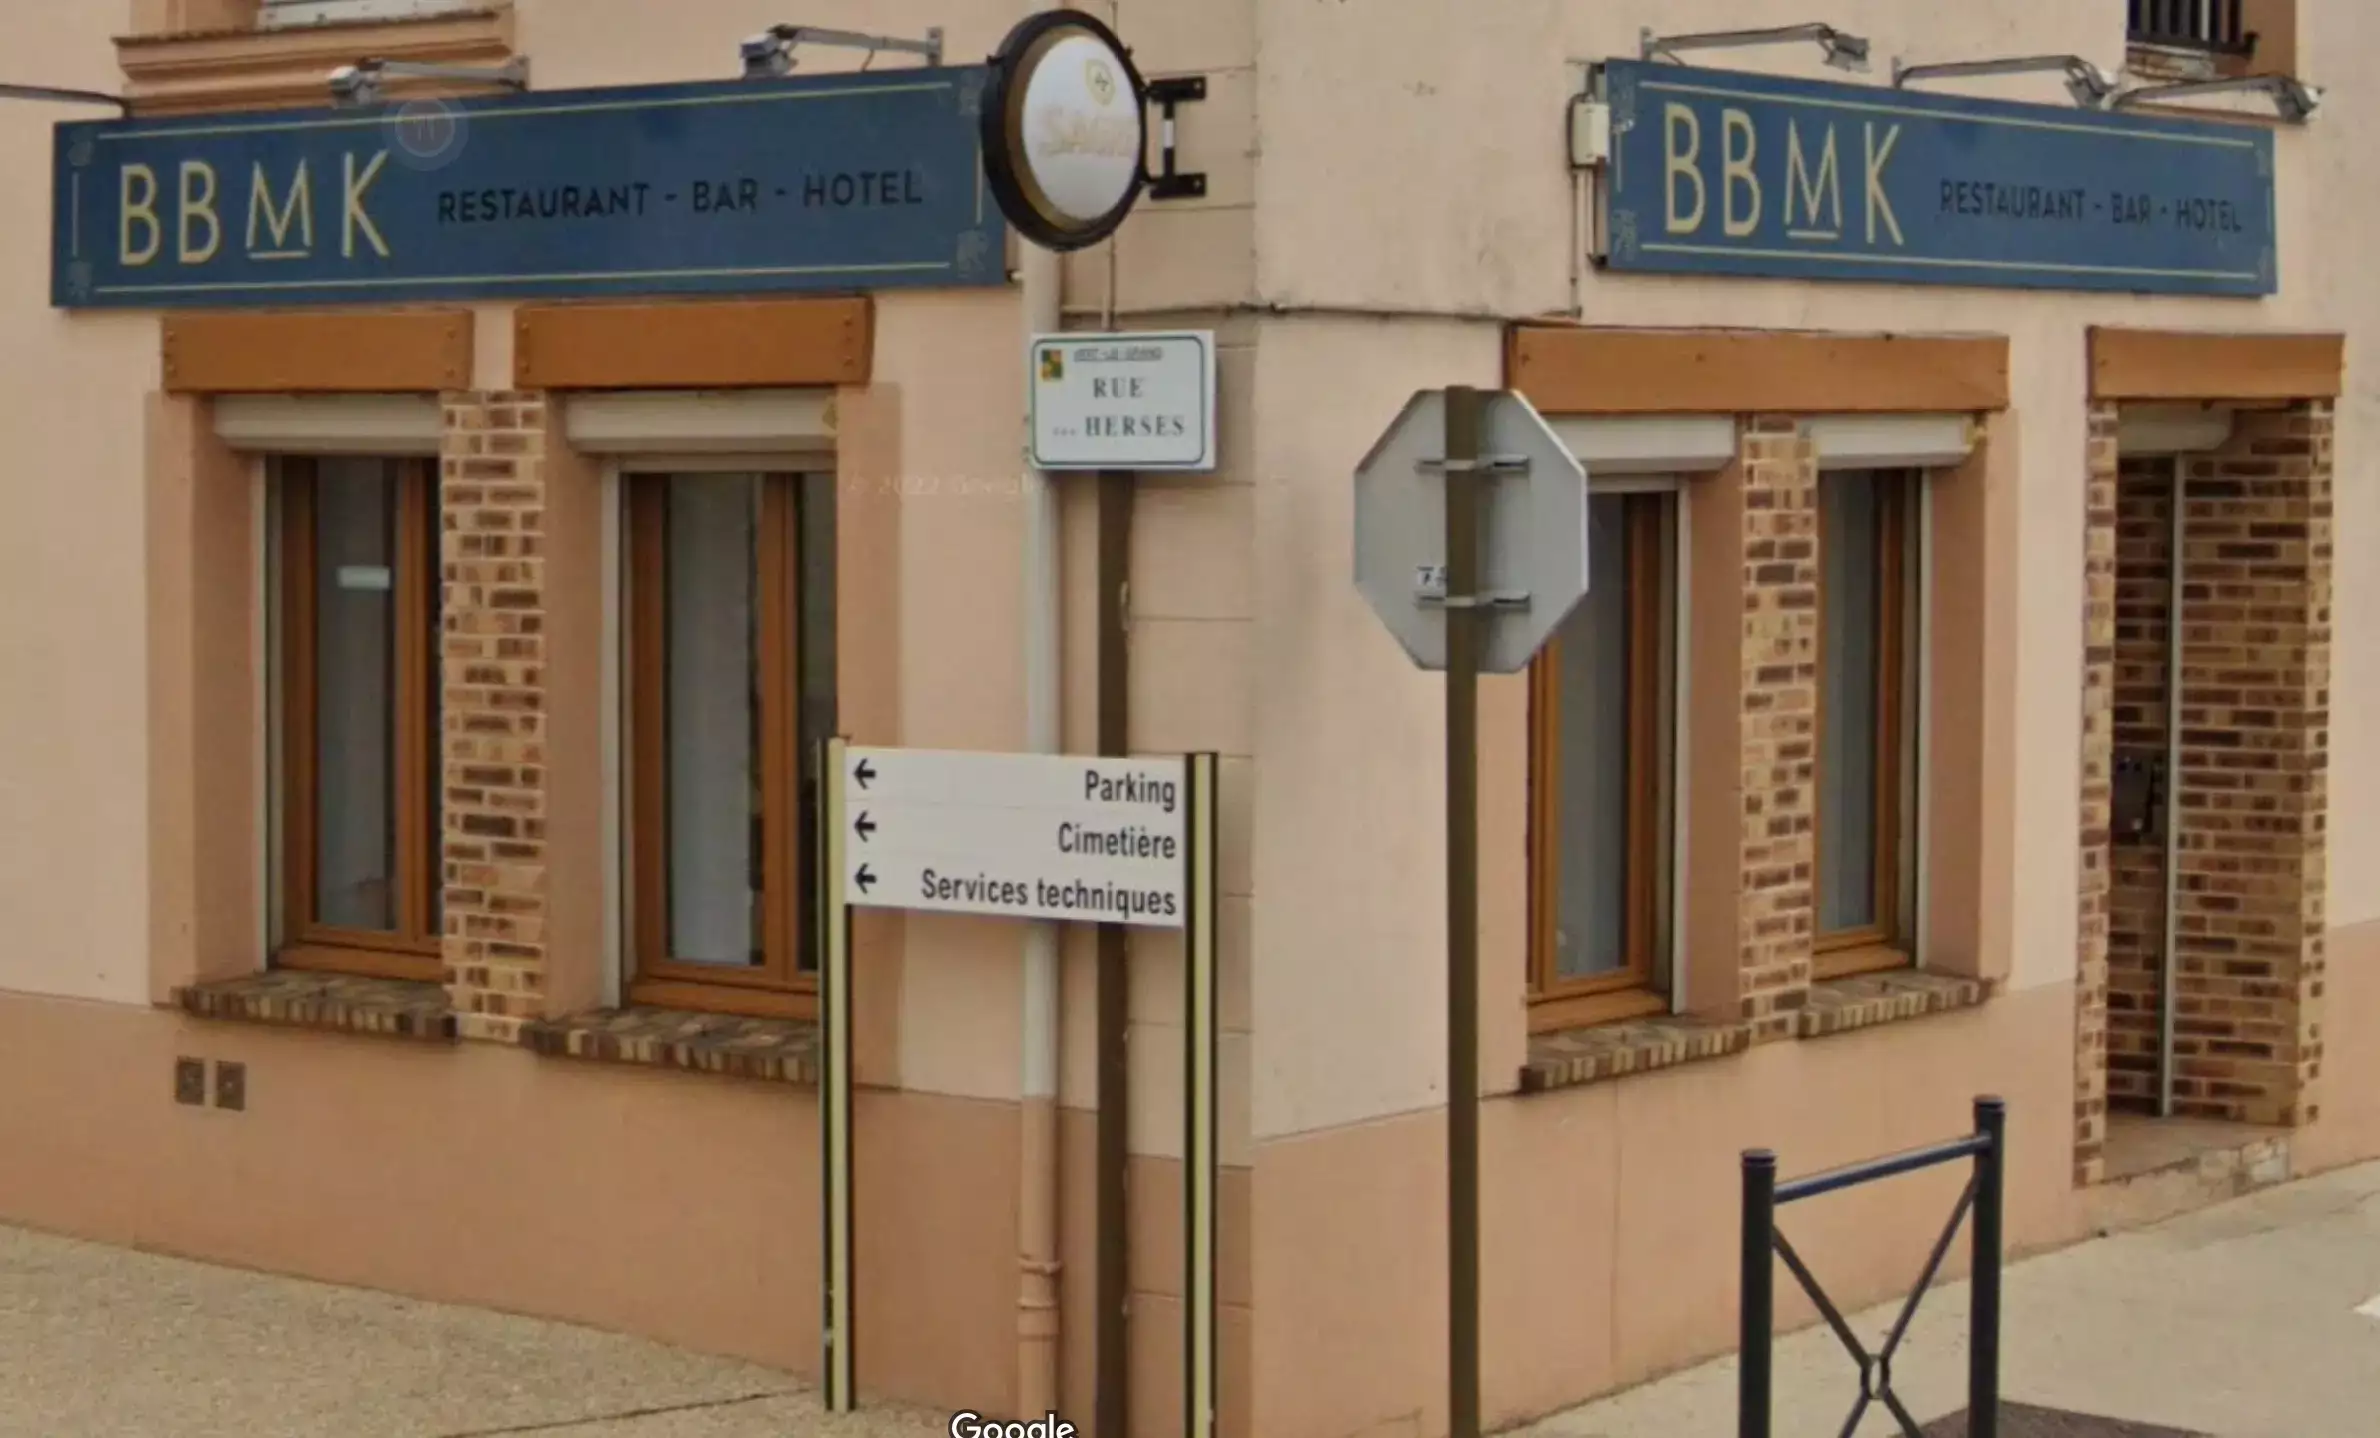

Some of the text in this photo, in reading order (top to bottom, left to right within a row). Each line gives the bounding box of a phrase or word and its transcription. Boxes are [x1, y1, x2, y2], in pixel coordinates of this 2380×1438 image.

[437, 182, 650, 223] RESTAURANT
[692, 177, 758, 213] BAR
[802, 169, 923, 208] HOTEL
[1663, 102, 1905, 246] BBMK
[118, 149, 390, 266] BBMK
[1939, 178, 2085, 222] RESTAURANT
[2110, 193, 2150, 226] BAR
[2175, 199, 2242, 234] HOTEL
[1092, 376, 1146, 399] RUE
[1084, 413, 1186, 438] HERSES
[1084, 769, 1177, 813] Parking
[1057, 822, 1177, 860] Cimetière
[920, 869, 1177, 920] Services techniques
